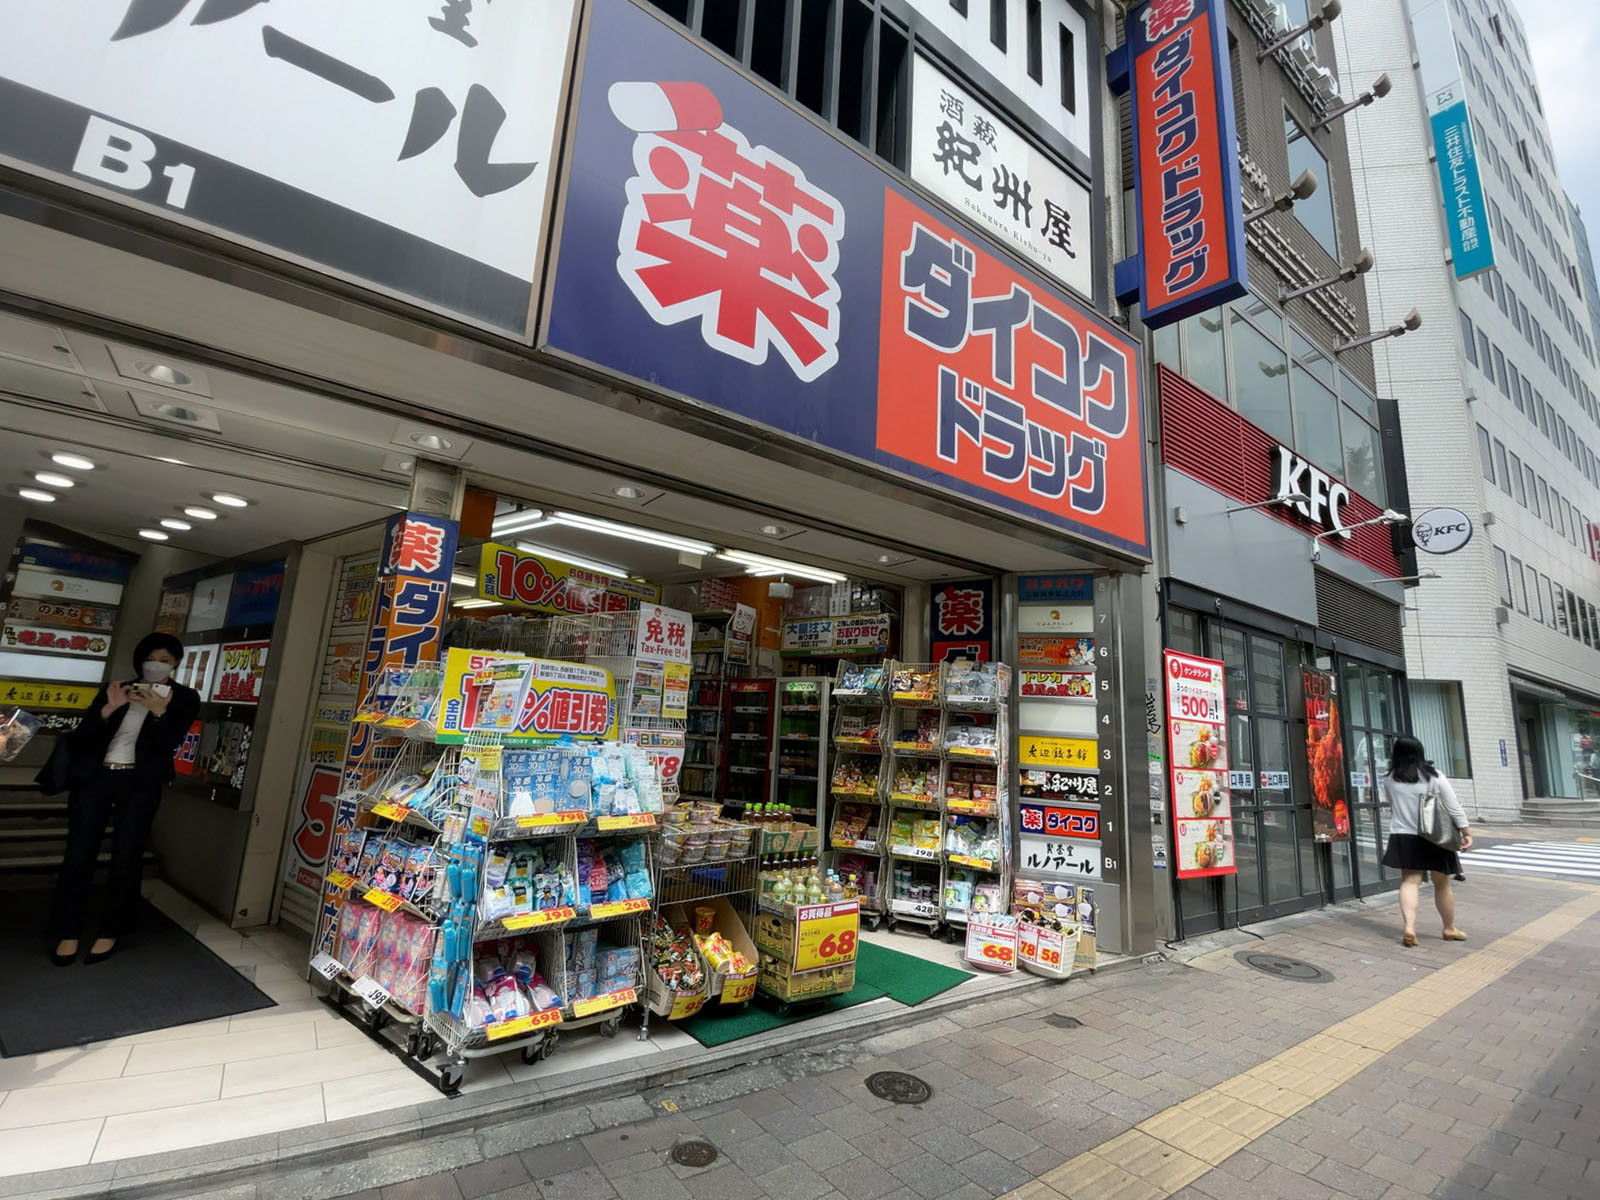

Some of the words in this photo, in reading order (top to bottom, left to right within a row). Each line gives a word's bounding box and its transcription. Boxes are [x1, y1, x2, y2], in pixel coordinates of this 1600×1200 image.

[110, 0, 539, 198] ール
[72, 114, 196, 210] B1
[932, 120, 1076, 259] 紀州屋
[964, 197, 1009, 234] Sakagura
[612, 100, 845, 382] 薬
[900, 221, 1129, 439] ダイコク
[936, 364, 1108, 515] ドラッグ
[1277, 445, 1351, 540] KFC
[1433, 522, 1466, 537] KFC
[390, 520, 446, 573] 薬
[935, 586, 984, 636] 薬
[1099, 614, 1107, 624] 7
[644, 617, 686, 647] 免税
[640, 642, 673, 657] Tax-Free
[1099, 647, 1108, 657] 6
[1025, 671, 1063, 683] トレカ
[1101, 680, 1109, 691] 5
[462, 675, 610, 734] 1%値引券
[444, 698, 460, 730] 全品
[1102, 715, 1110, 725] 4
[1103, 749, 1111, 760] 3
[1104, 785, 1113, 796] 2
[558, 812, 587, 822] 798
[630, 814, 655, 825] 248
[1021, 807, 1043, 830] 薬
[1047, 812, 1097, 834] ダイコク
[1106, 821, 1113, 832] 1
[915, 849, 933, 857] 198
[1027, 853, 1095, 874] ルノアール
[1104, 858, 1117, 870] B1
[625, 899, 648, 912] 268
[915, 904, 934, 914] 428
[543, 908, 574, 922] 198
[818, 929, 856, 958] 68
[1021, 940, 1036, 957] 78
[983, 944, 1013, 962] 68
[1041, 947, 1060, 964] 58
[368, 989, 386, 1005] 198
[609, 990, 635, 1004] 348
[531, 1010, 561, 1026] 698
